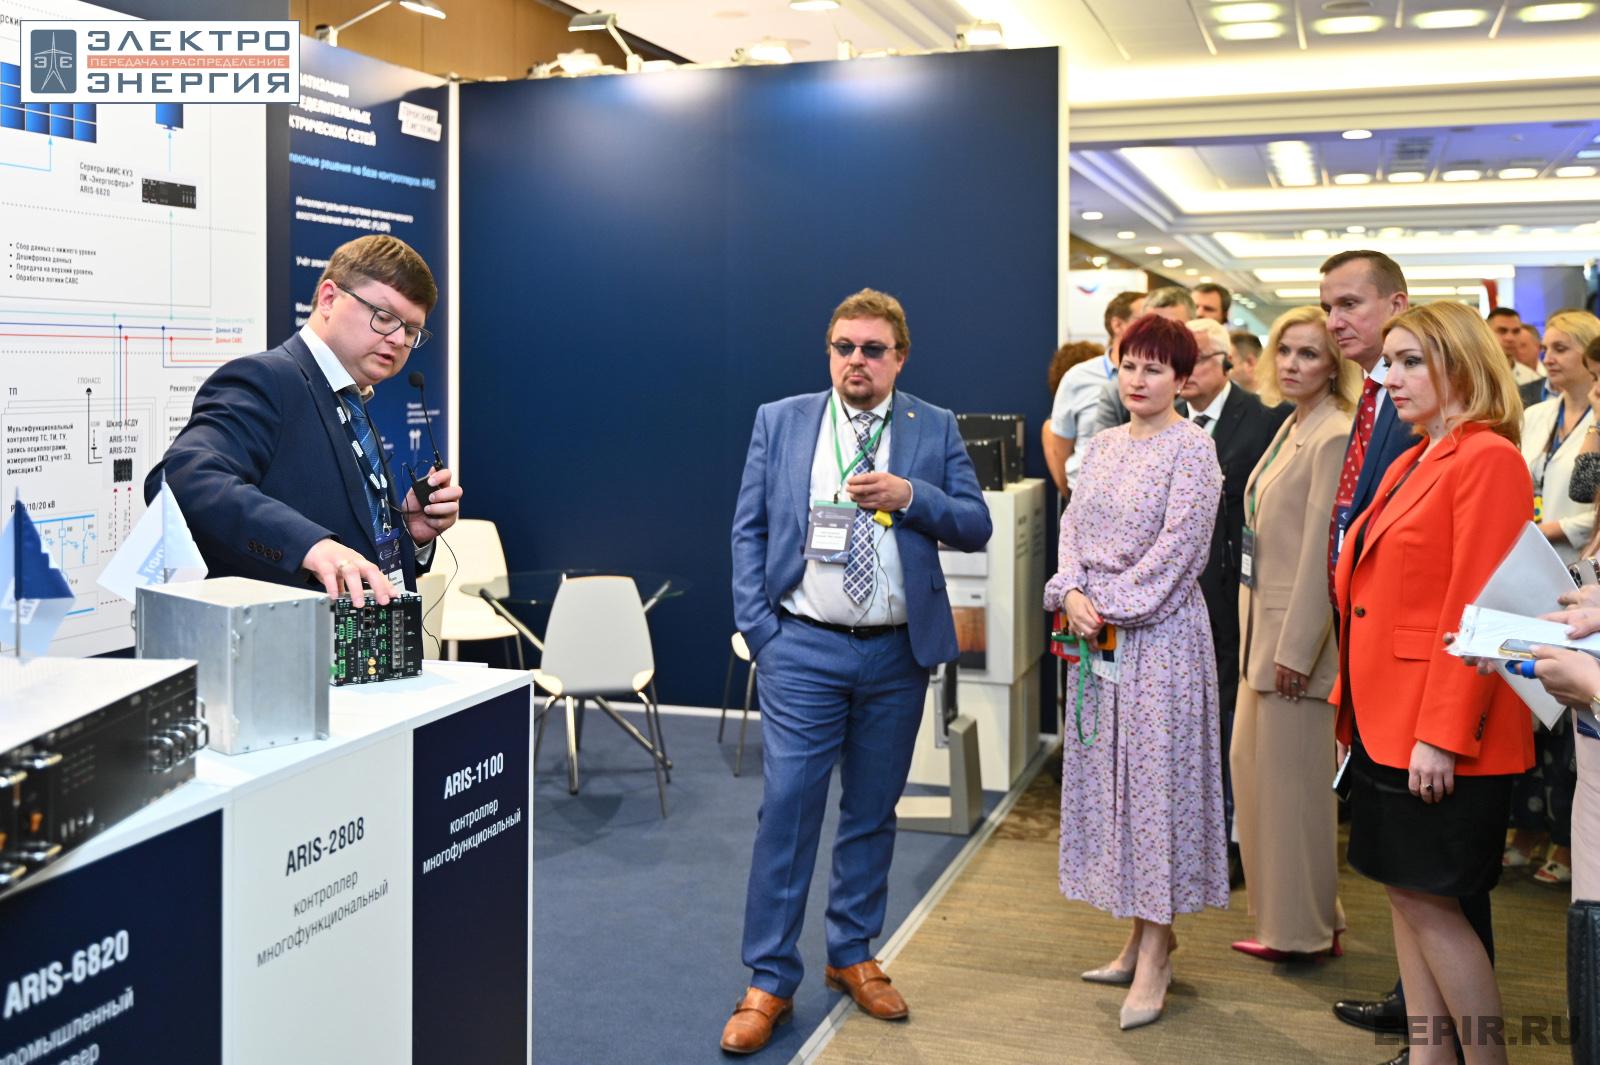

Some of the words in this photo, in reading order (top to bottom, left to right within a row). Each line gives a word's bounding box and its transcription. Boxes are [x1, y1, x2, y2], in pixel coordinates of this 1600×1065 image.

[16, 242, 30, 251] Сбор
[16, 263, 43, 272] Передача
[16, 273, 45, 282] Обработка
[9, 387, 18, 396] ТП
[7, 422, 74, 433] Мультифункциональный
[7, 435, 39, 443] контроллер
[7, 456, 36, 465] измерение
[7, 467, 34, 476] фиксация
[443, 752, 504, 800] ARIS-1100
[450, 799, 498, 835] контроллер
[285, 816, 365, 877] ARIS-2808
[422, 807, 521, 874] многофункциональный
[293, 871, 358, 917] контроллер
[256, 878, 389, 968] многофункциональный
[3, 929, 129, 1019] ARIS-6820
[0, 985, 134, 1065] ромышленный
